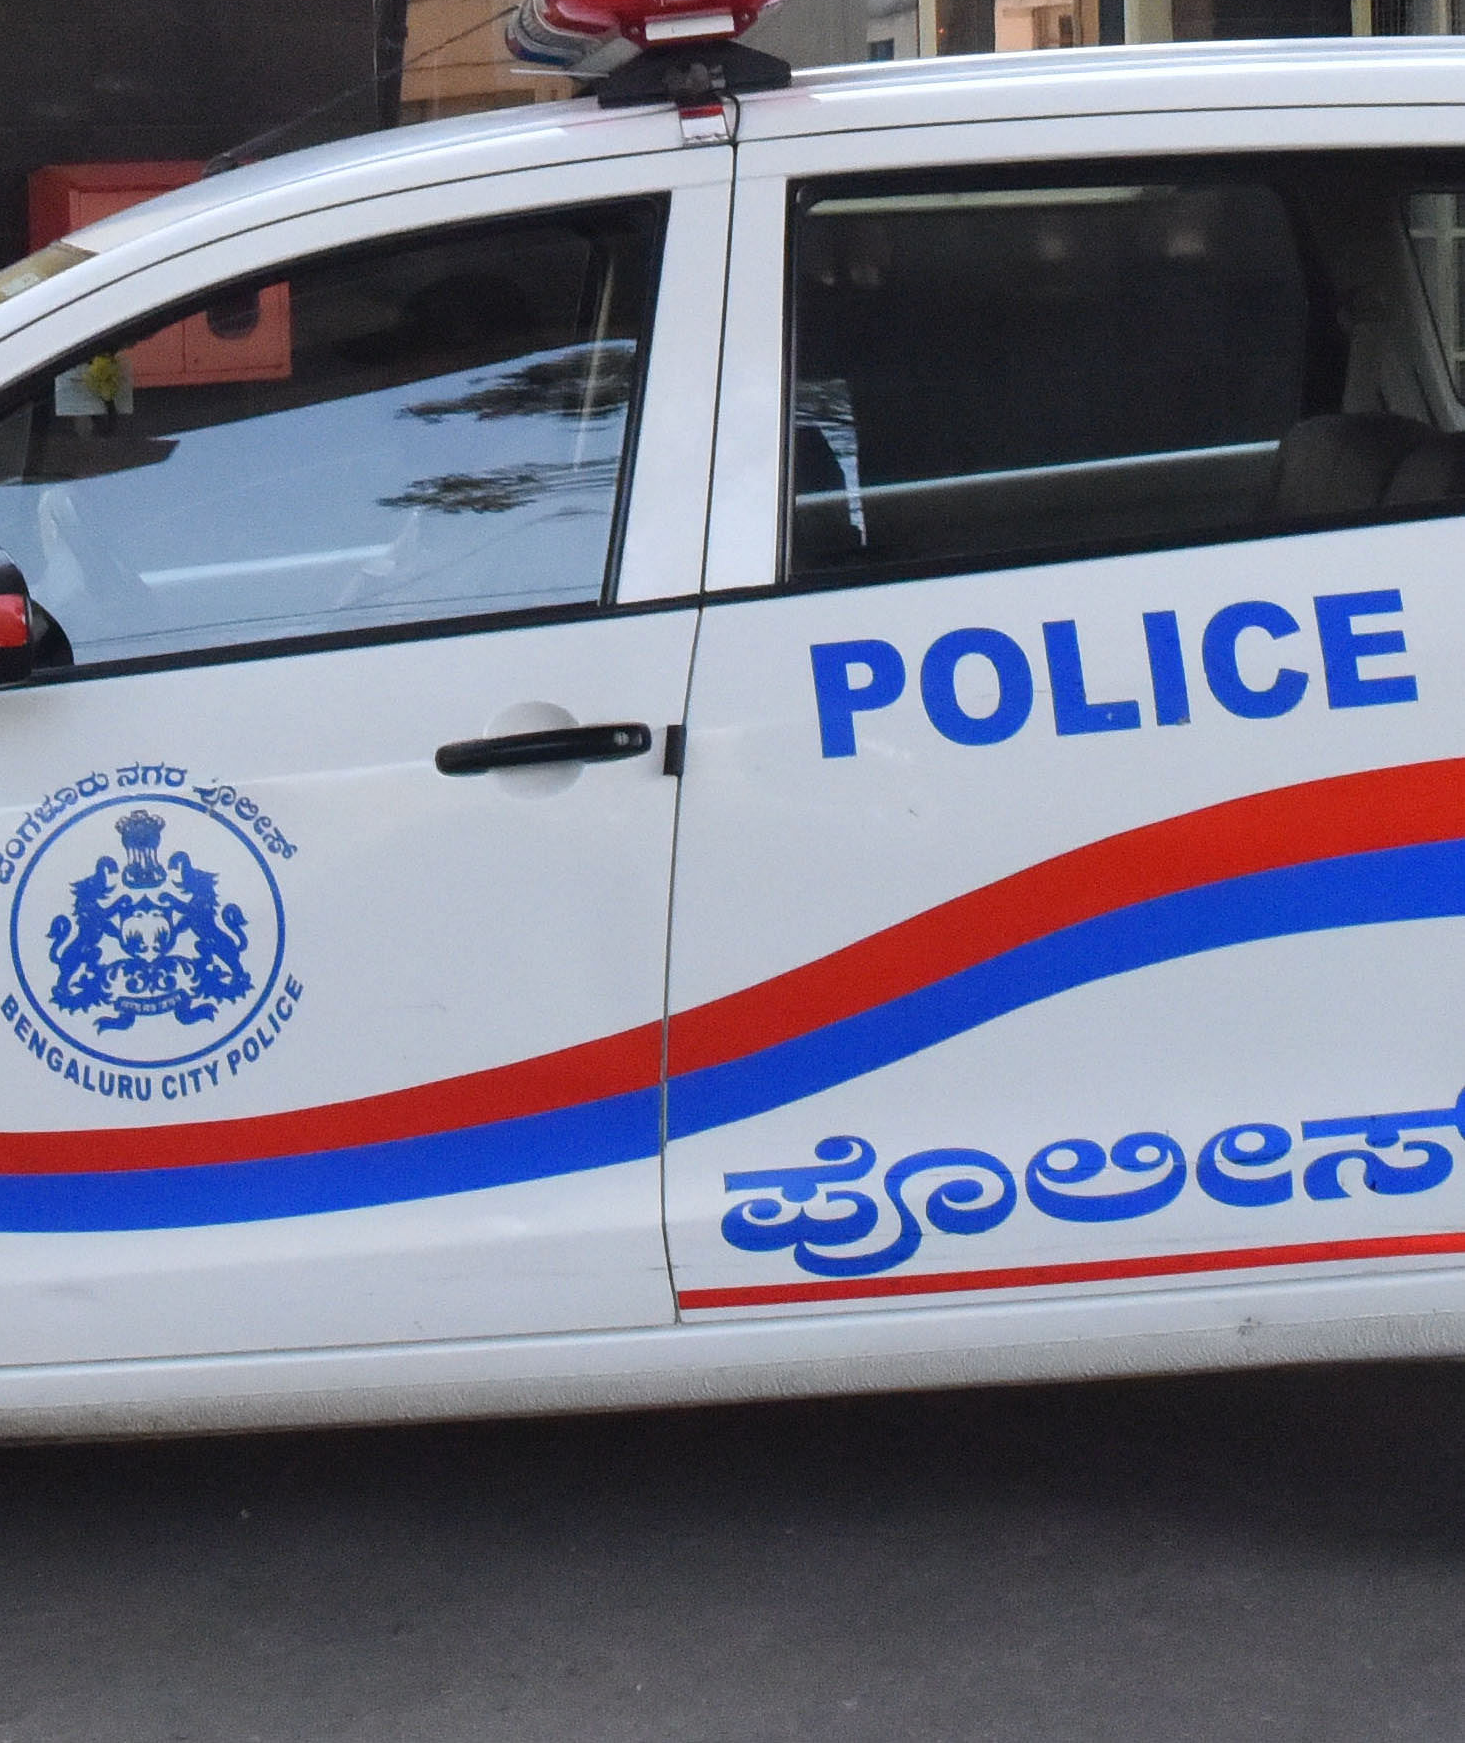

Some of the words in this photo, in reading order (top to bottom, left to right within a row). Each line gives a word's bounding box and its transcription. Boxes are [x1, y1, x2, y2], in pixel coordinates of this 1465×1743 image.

[810, 588, 1419, 759] POLICE
[0, 992, 153, 1102] BENGALURU
[161, 1059, 220, 1101] CITY
[226, 972, 305, 1078] POLICE
